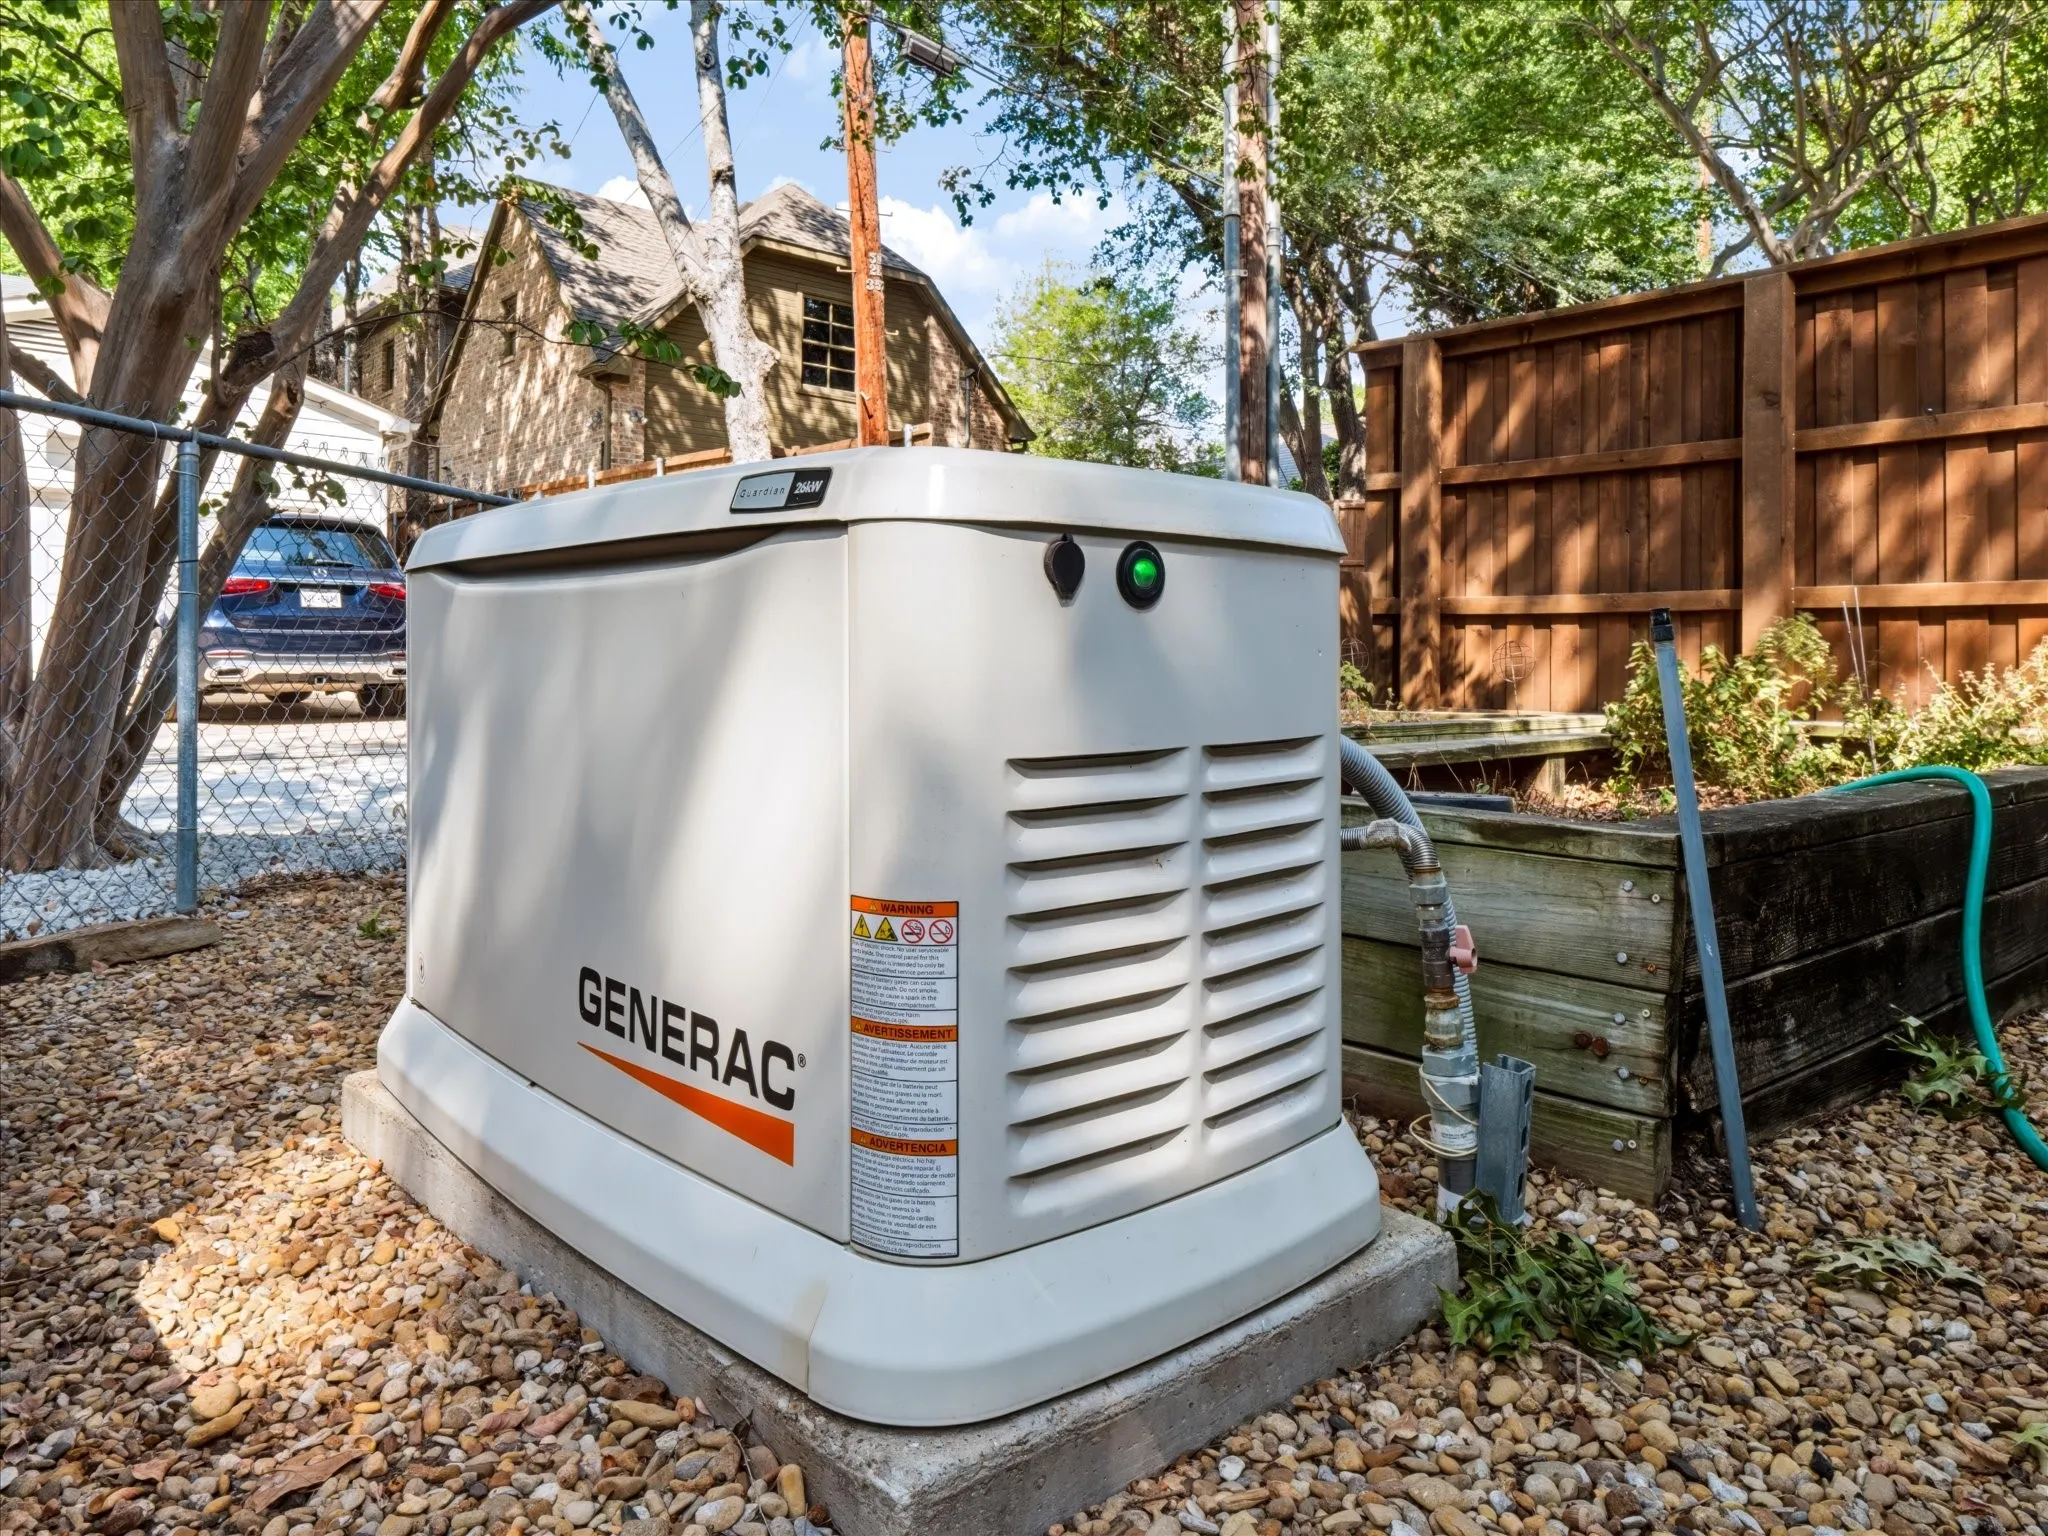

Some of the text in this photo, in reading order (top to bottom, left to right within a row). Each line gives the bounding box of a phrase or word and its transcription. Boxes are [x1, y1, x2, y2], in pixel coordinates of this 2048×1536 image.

[739, 480, 824, 498] Guardian 26kW
[880, 903, 934, 915] WARNING
[579, 966, 796, 1112] GENERAC
[863, 1024, 953, 1039] AVERTISSEMENT
[869, 1137, 947, 1153] ADVERTENCIA
